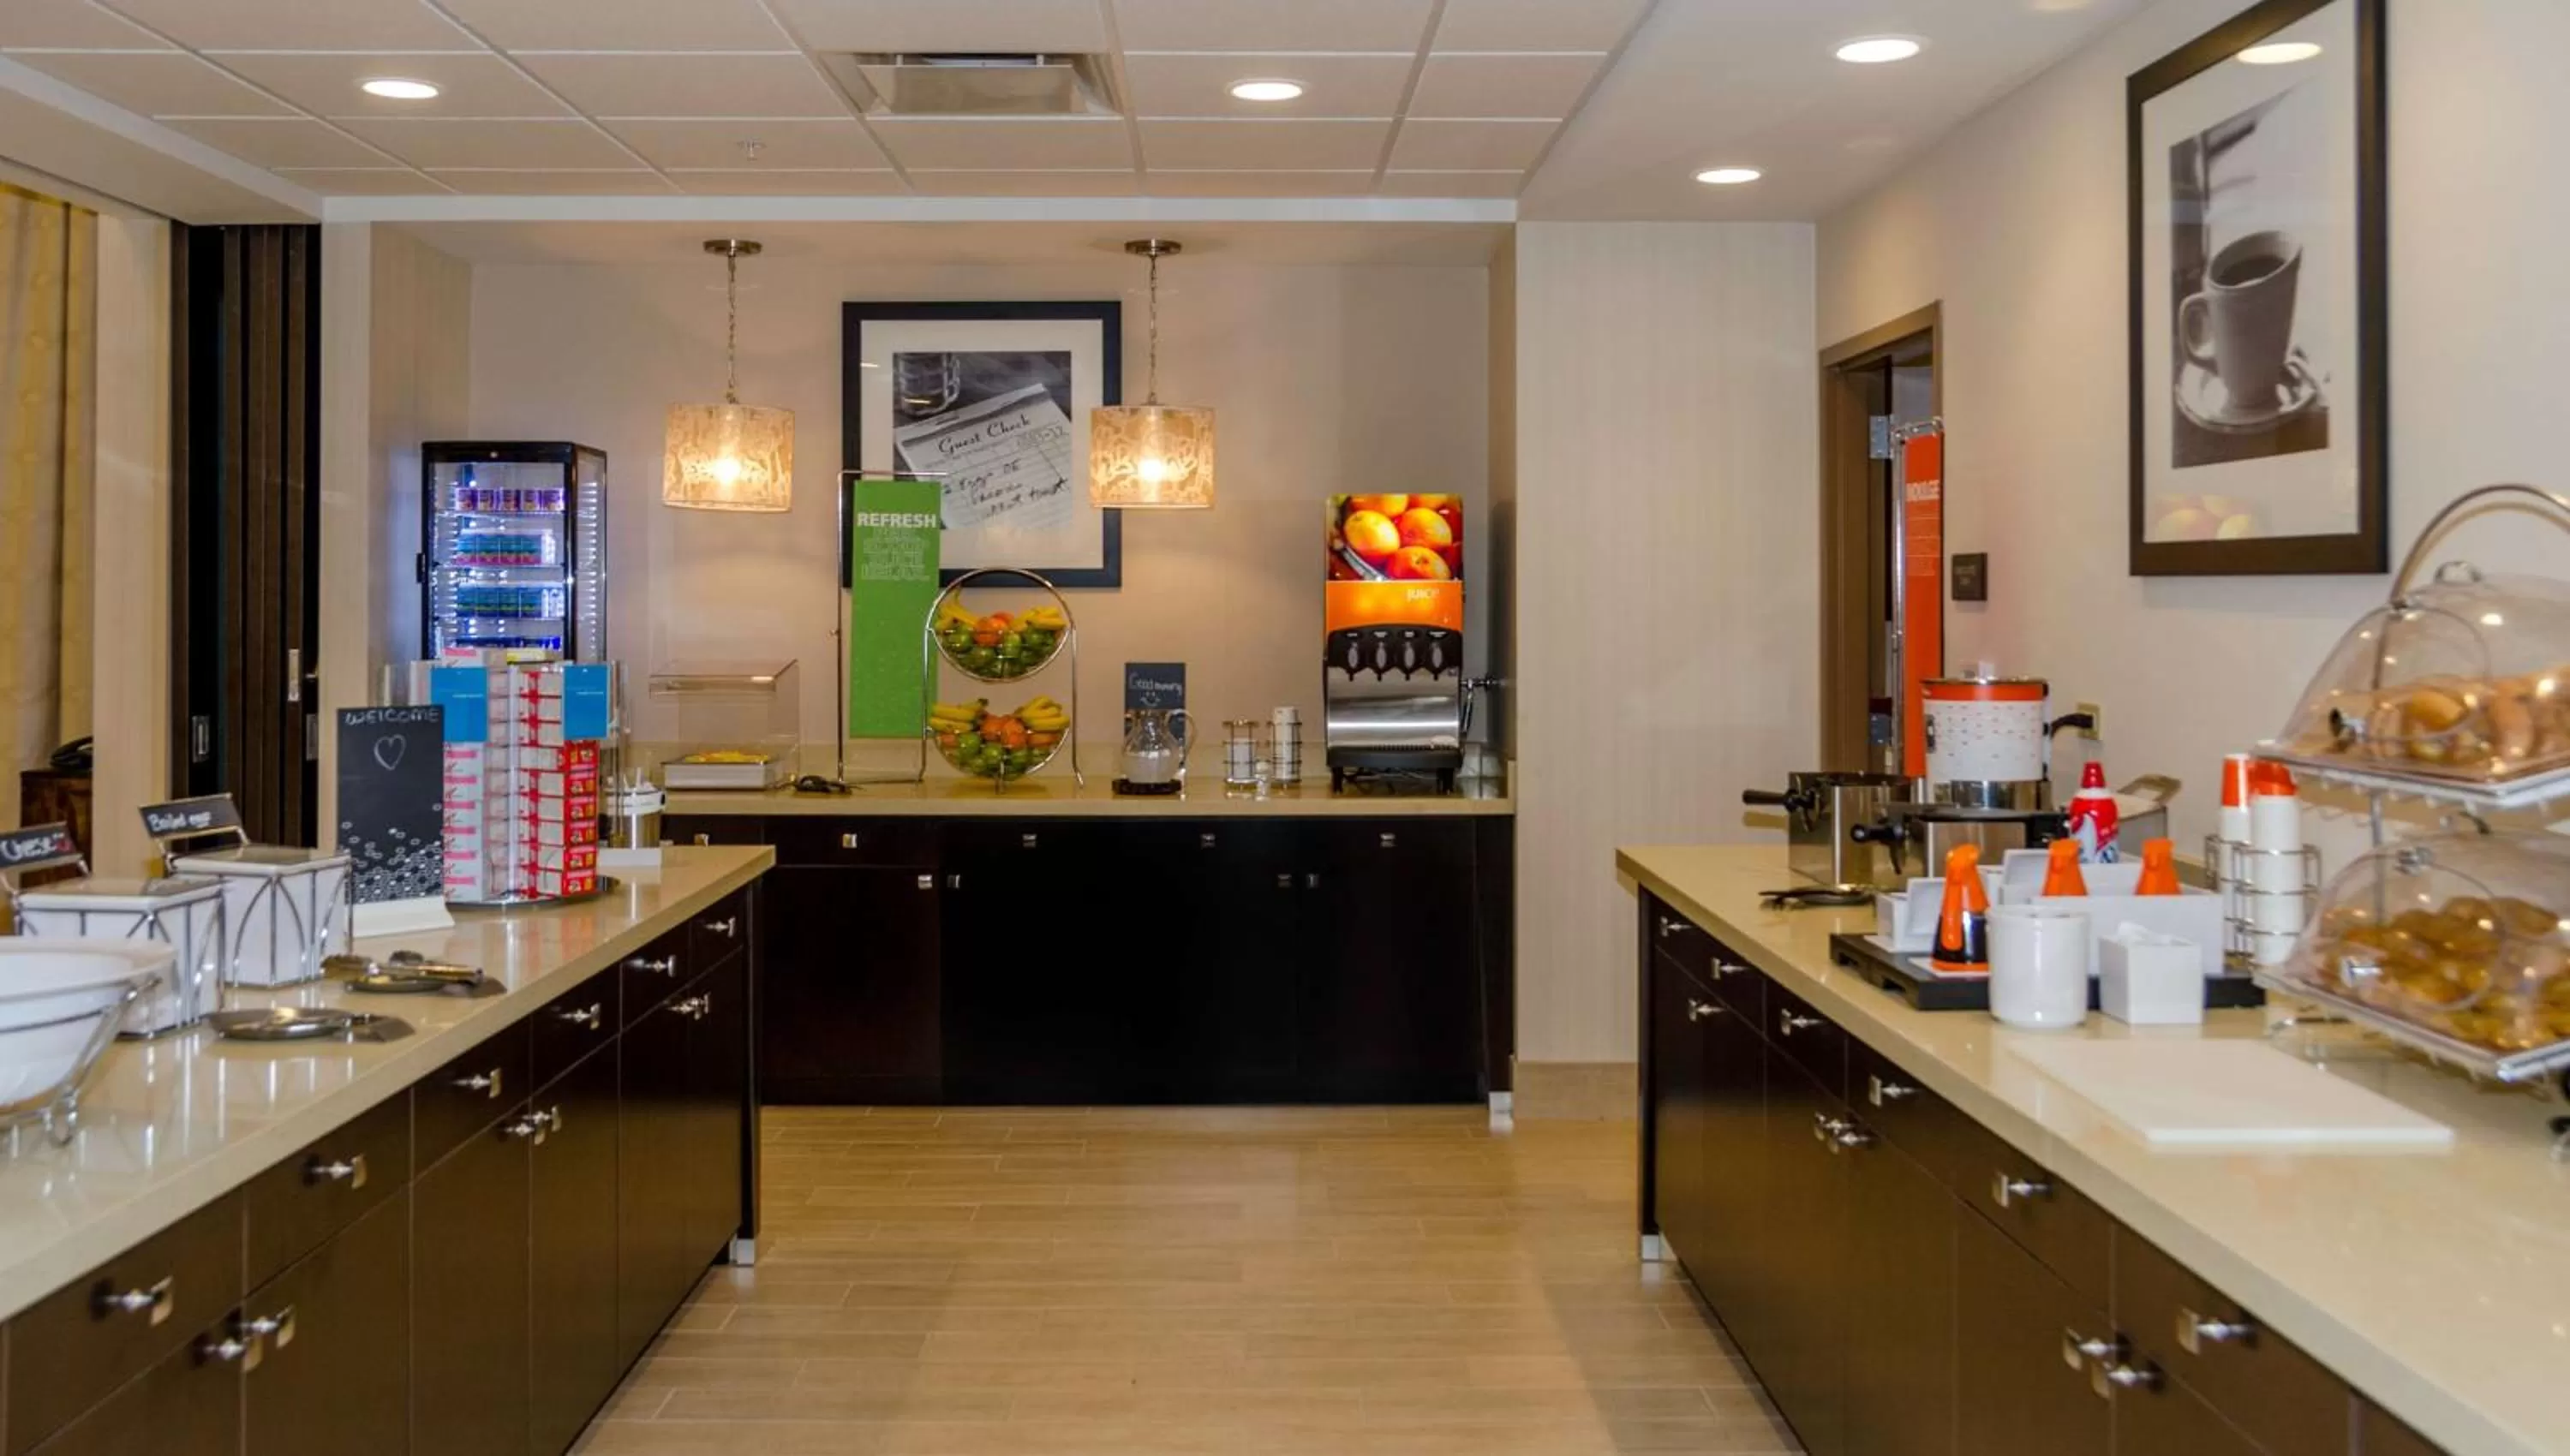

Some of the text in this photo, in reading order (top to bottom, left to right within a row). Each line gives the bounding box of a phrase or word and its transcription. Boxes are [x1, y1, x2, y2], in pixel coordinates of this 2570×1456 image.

[939, 433, 980, 455] Guest
[987, 414, 1030, 438] Check
[858, 512, 936, 528] REFRESH
[345, 707, 439, 725] WELCOME
